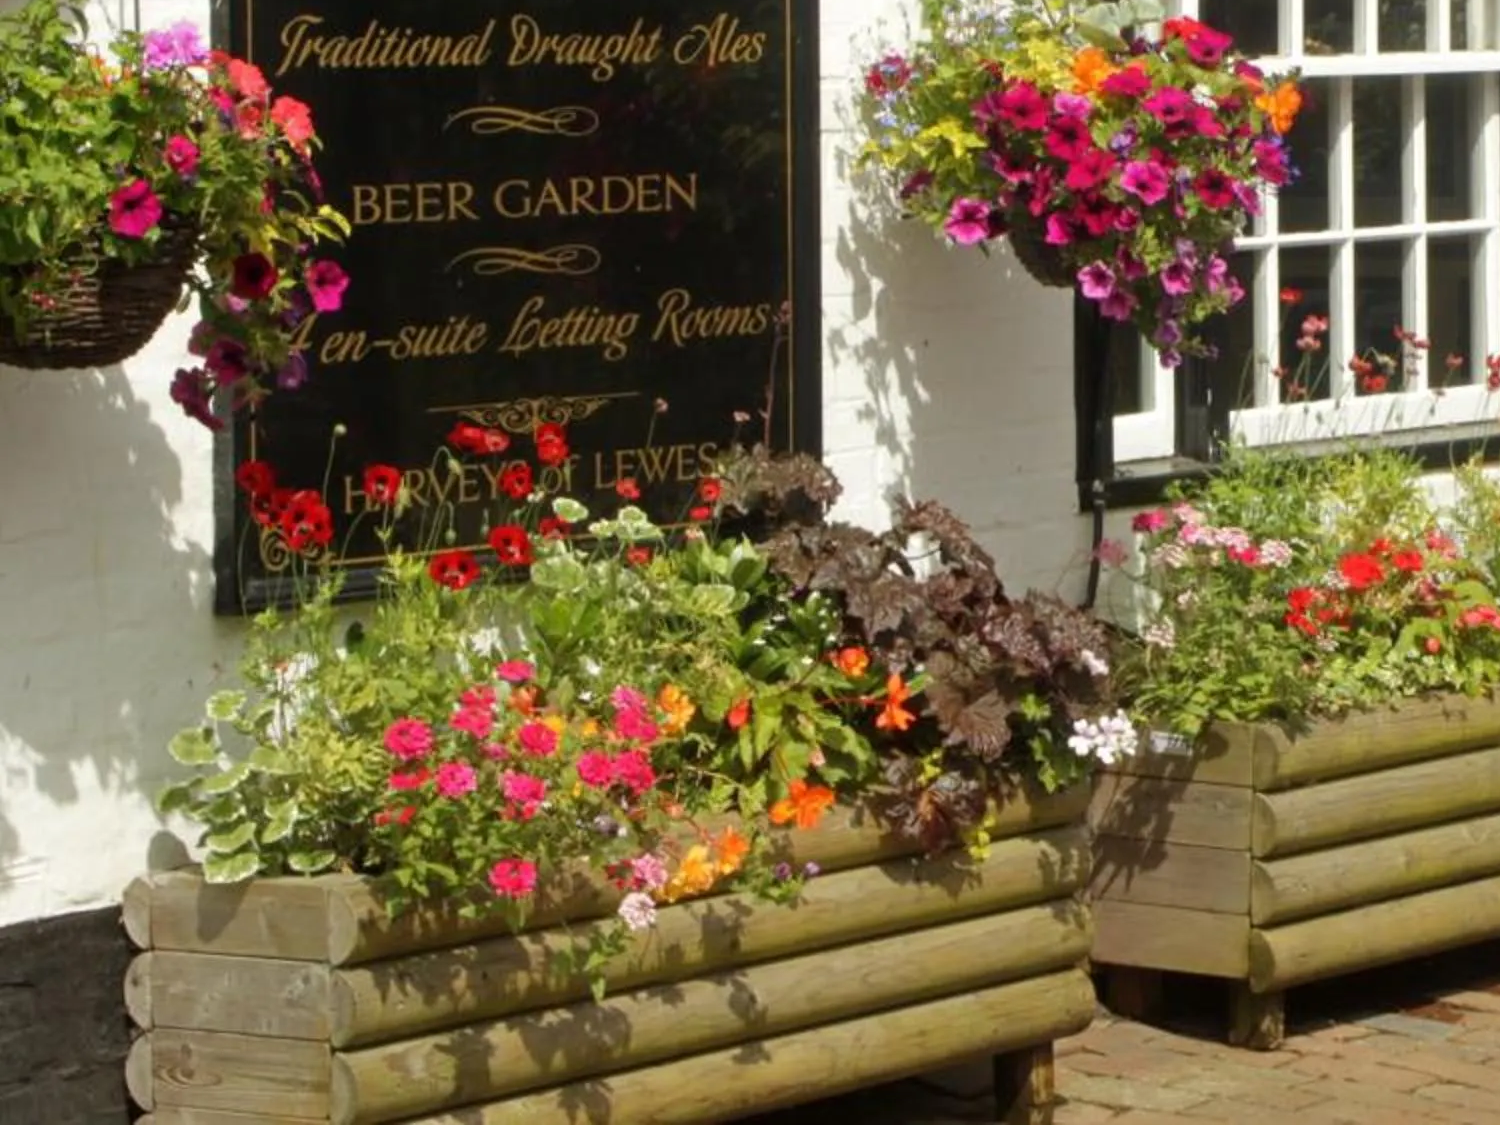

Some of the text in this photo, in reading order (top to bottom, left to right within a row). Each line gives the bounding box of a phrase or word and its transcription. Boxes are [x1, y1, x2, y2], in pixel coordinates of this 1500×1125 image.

[275, 12, 768, 82] Traditional Draught Ales
[352, 172, 699, 225] BEER GARDEN
[320, 316, 490, 364] en-suite
[499, 295, 640, 361] Letting
[651, 288, 771, 345] Rooms
[343, 459, 534, 515] HRVEY
[593, 442, 718, 489] LEWES
